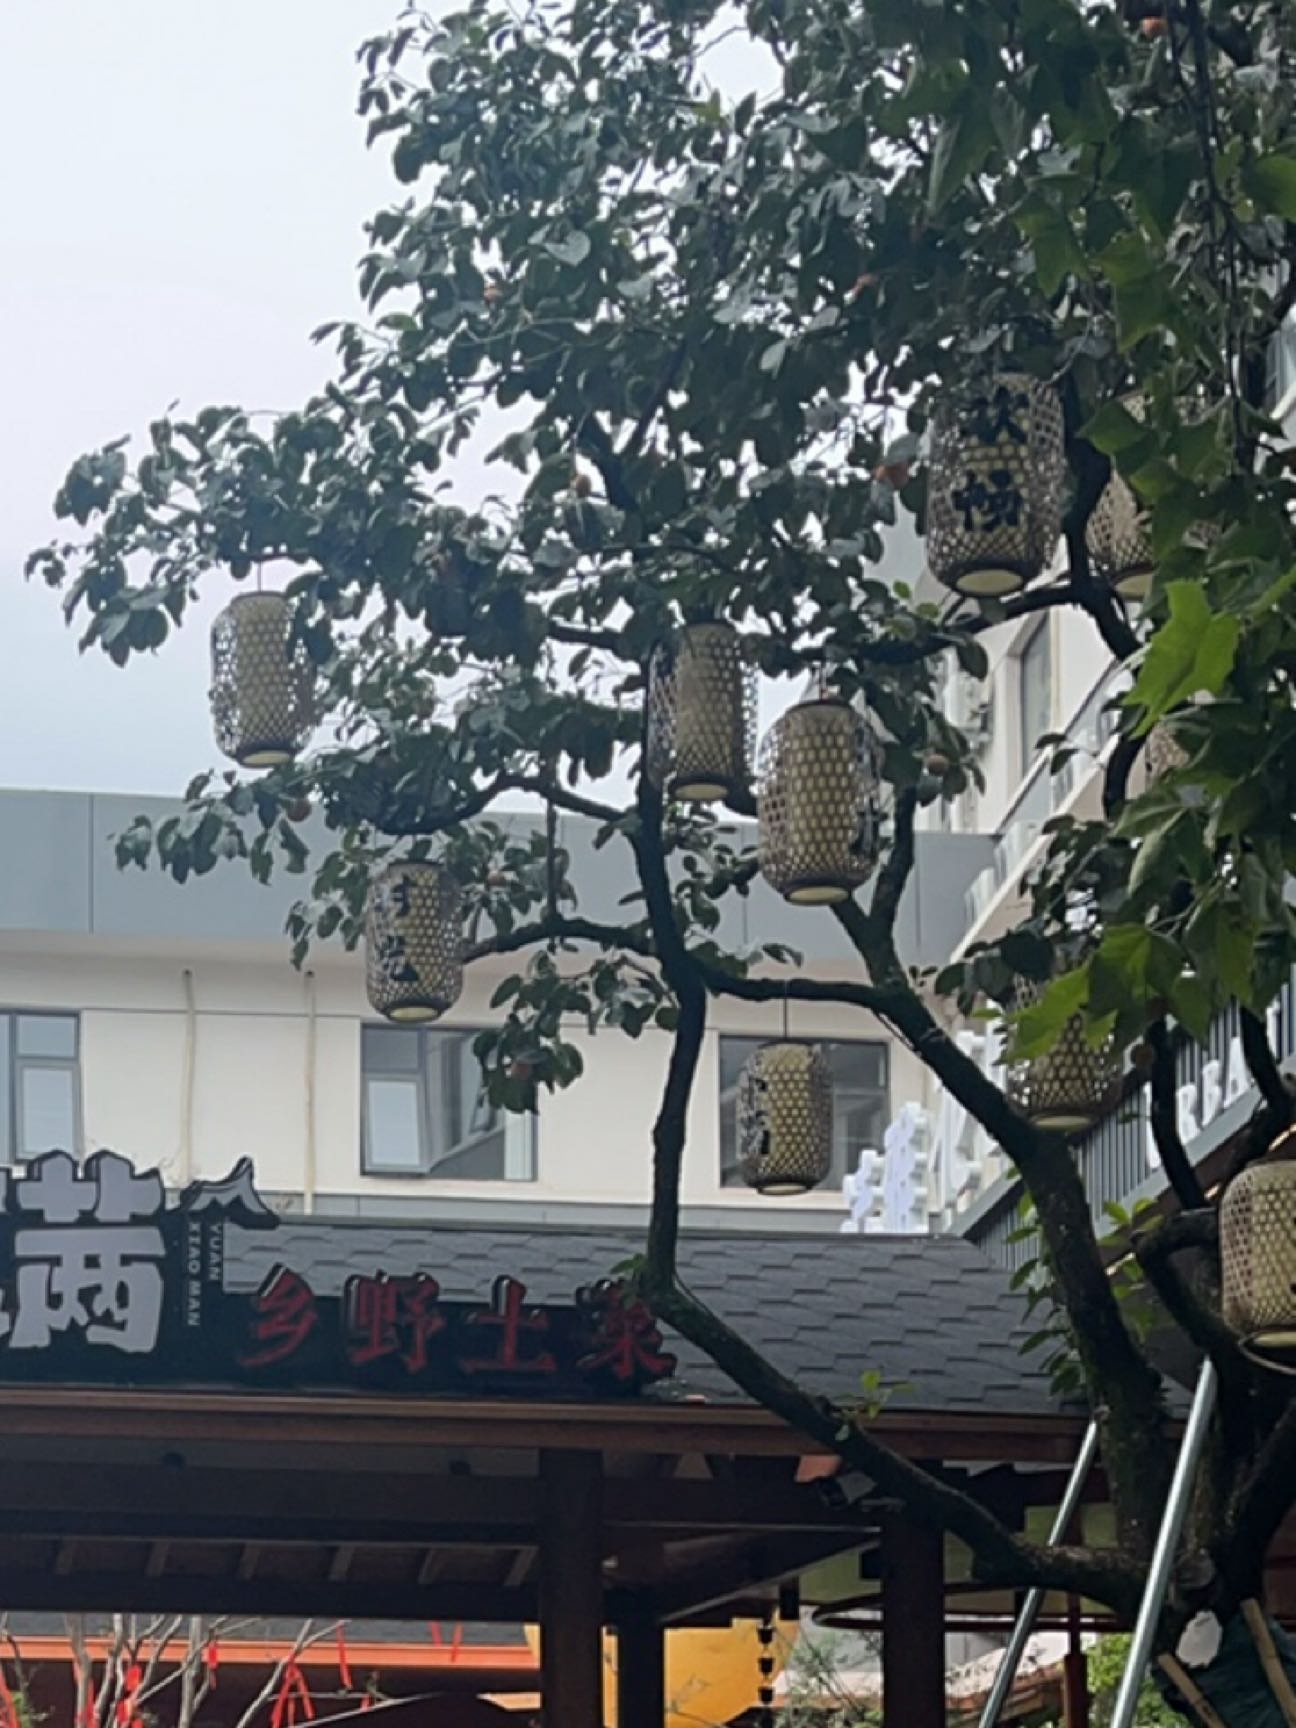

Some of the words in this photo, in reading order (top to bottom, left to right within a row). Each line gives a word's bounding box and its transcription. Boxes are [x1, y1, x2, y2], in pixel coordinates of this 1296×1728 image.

[187, 1280, 201, 1326] MAN
[237, 1264, 677, 1380] 乡野土菜
